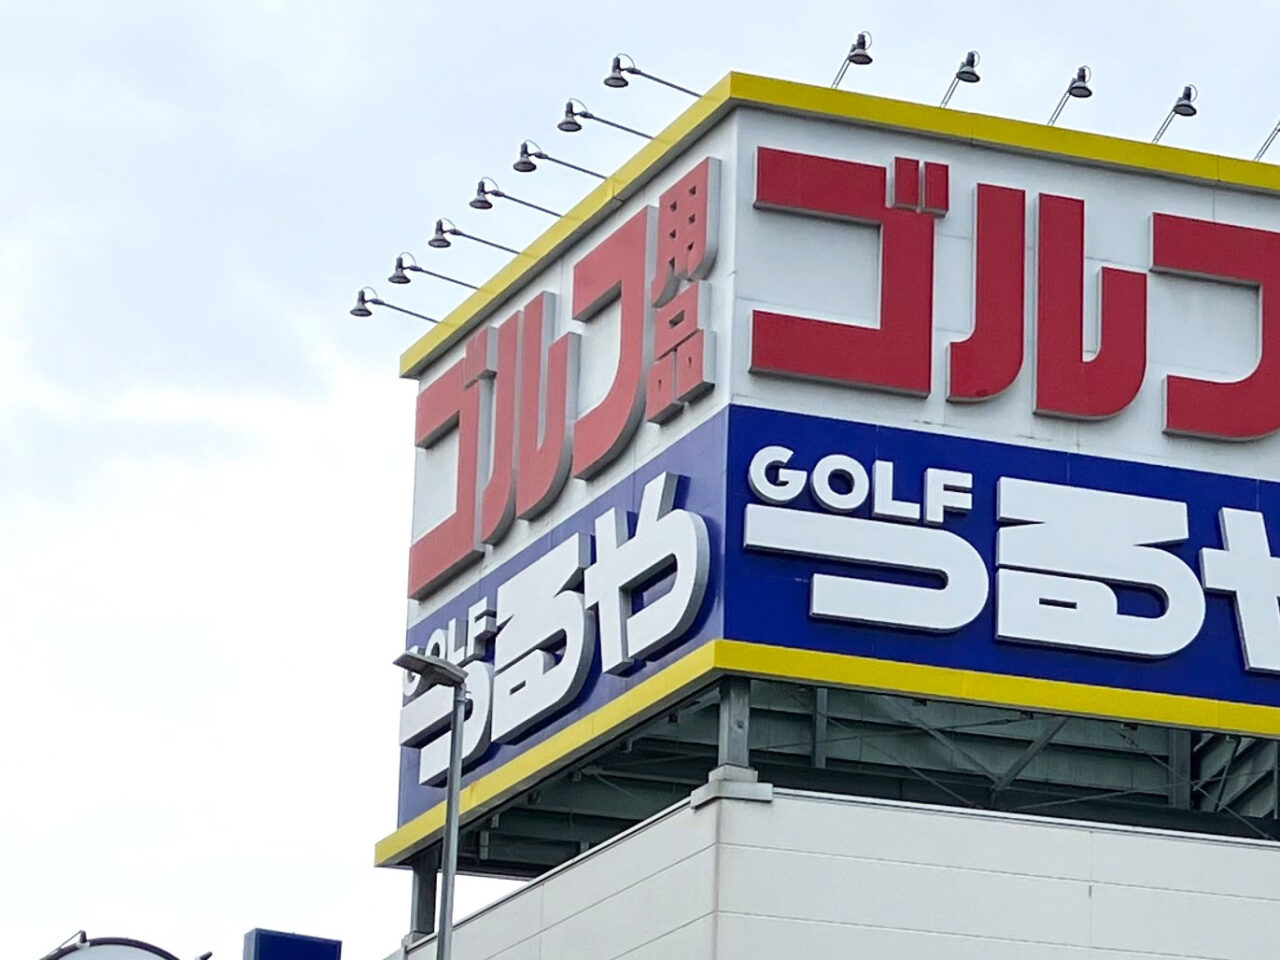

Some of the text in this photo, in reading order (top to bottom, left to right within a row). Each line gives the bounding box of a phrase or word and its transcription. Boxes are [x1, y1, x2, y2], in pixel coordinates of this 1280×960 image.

[749, 445, 973, 526] GOLF
[400, 471, 709, 787] つるや
